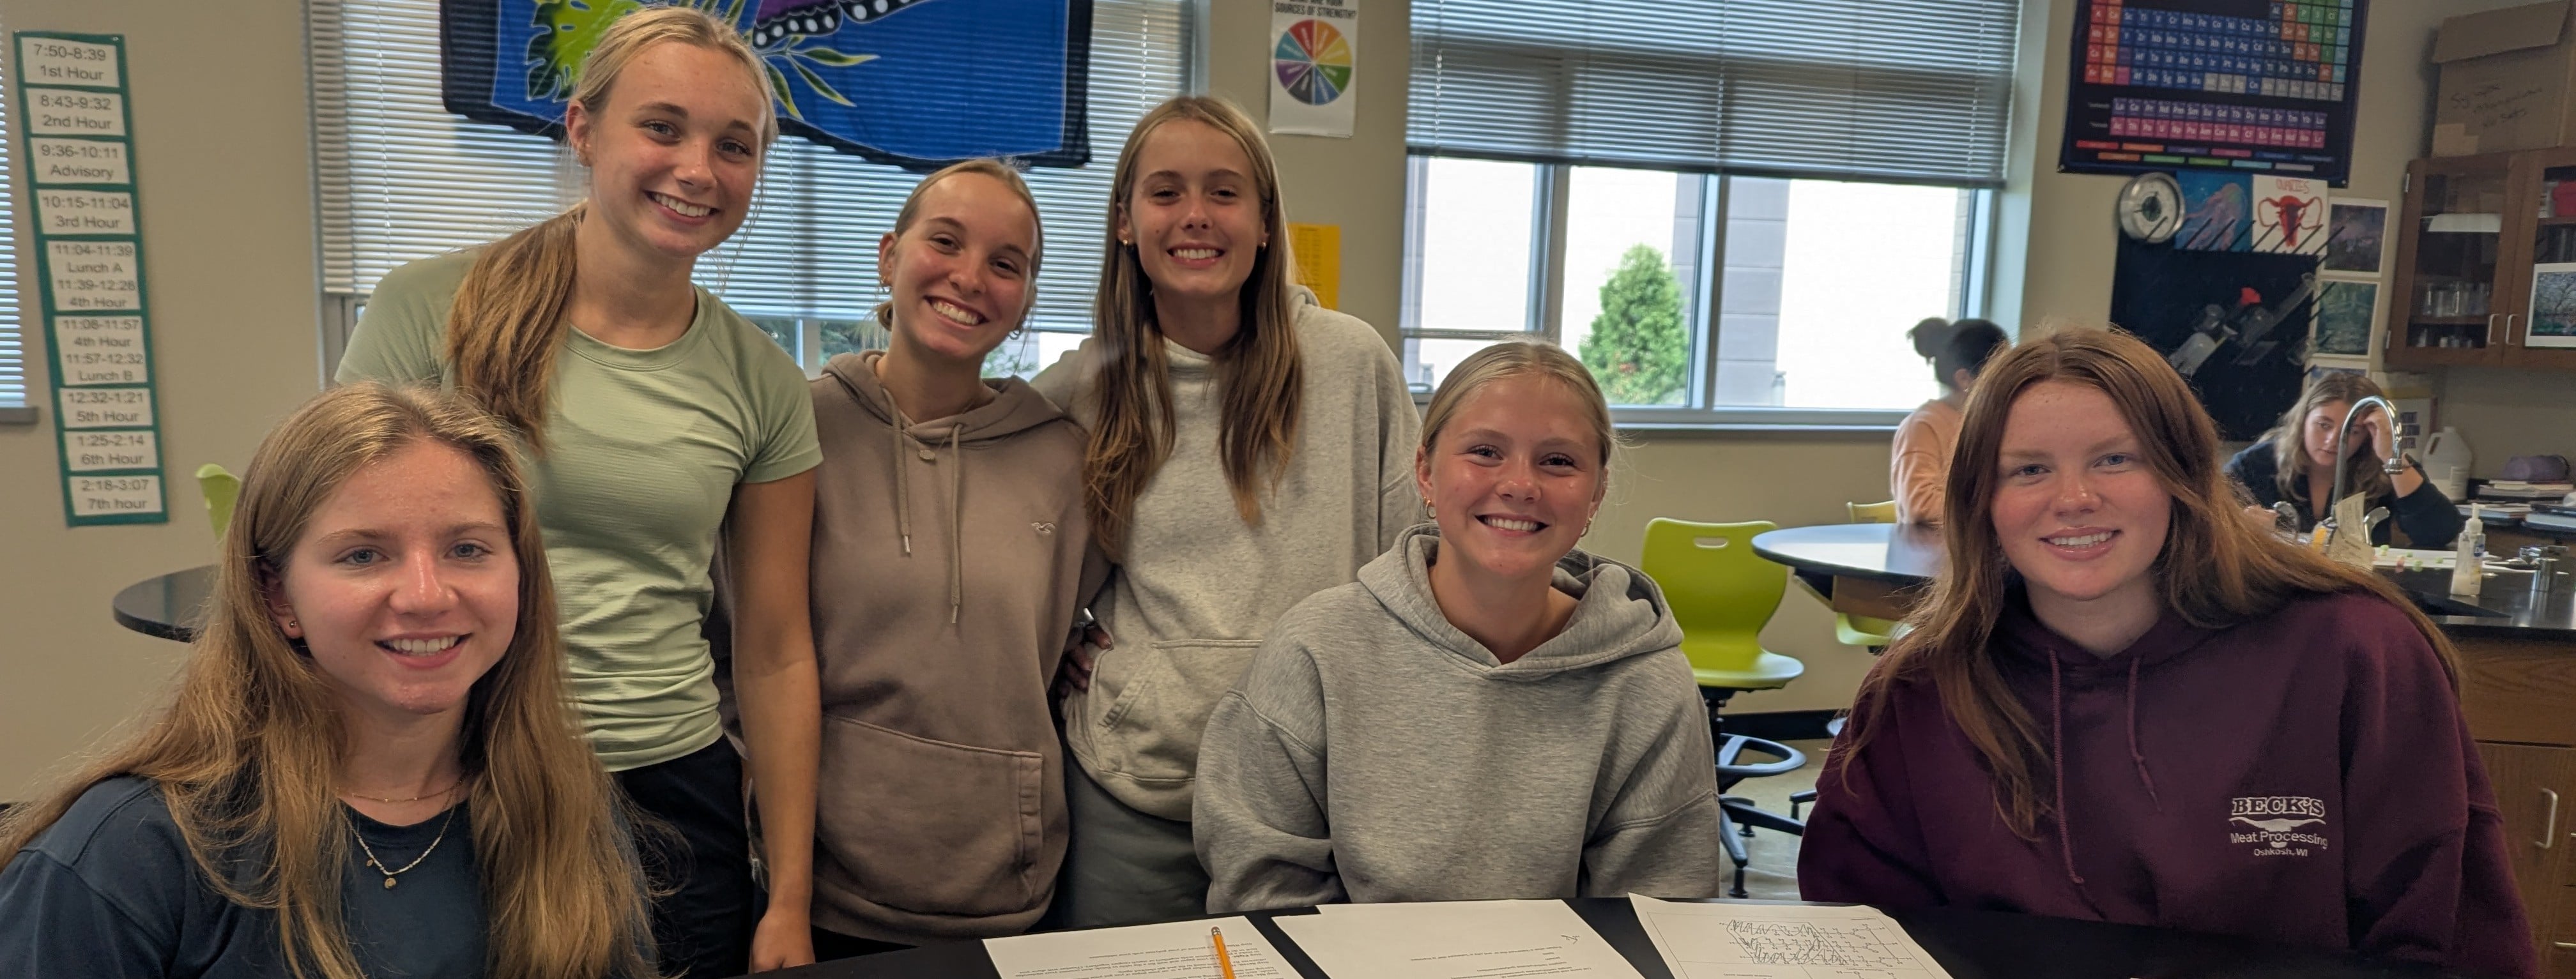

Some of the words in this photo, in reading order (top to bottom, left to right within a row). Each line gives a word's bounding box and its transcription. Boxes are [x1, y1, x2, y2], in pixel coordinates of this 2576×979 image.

[1275, 3, 1305, 15] SOURCES
[1307, 6, 1315, 15] OF
[34, 43, 106, 61] 7:50-8:39
[40, 65, 62, 77] 1st
[68, 66, 104, 80] Hour
[41, 95, 112, 110] 8:43-9:32
[43, 114, 71, 128] 2nd
[76, 117, 112, 130] Hour
[41, 145, 119, 159] 9:36-10:11
[50, 164, 114, 180] Advisory
[43, 195, 129, 209] 10:15-11:04
[56, 215, 79, 228] 3rd
[85, 216, 120, 229] Hour
[56, 244, 134, 257] 11:04-11:39
[67, 261, 109, 273] Lunch
[112, 261, 123, 273] A
[70, 297, 89, 307] 4th
[95, 297, 127, 308] Hour
[74, 337, 95, 347] 4th
[99, 337, 131, 347] Hour
[66, 354, 144, 365] 11:57-12:32
[79, 370, 120, 381] Lunch
[124, 370, 134, 381] B
[68, 392, 144, 404] 12:32-1:21
[77, 411, 100, 422] 5th
[104, 411, 139, 422] Hour
[77, 435, 145, 446] 1:25-2:14
[81, 453, 104, 465] 6th
[110, 453, 144, 465] Hour
[82, 480, 149, 491] 2:18-3:07
[88, 498, 111, 510] 7th
[115, 497, 148, 510] hour
[2232, 796, 2326, 817] BECK'S
[2230, 831, 2257, 844] Meat
[2260, 831, 2328, 849] Processing
